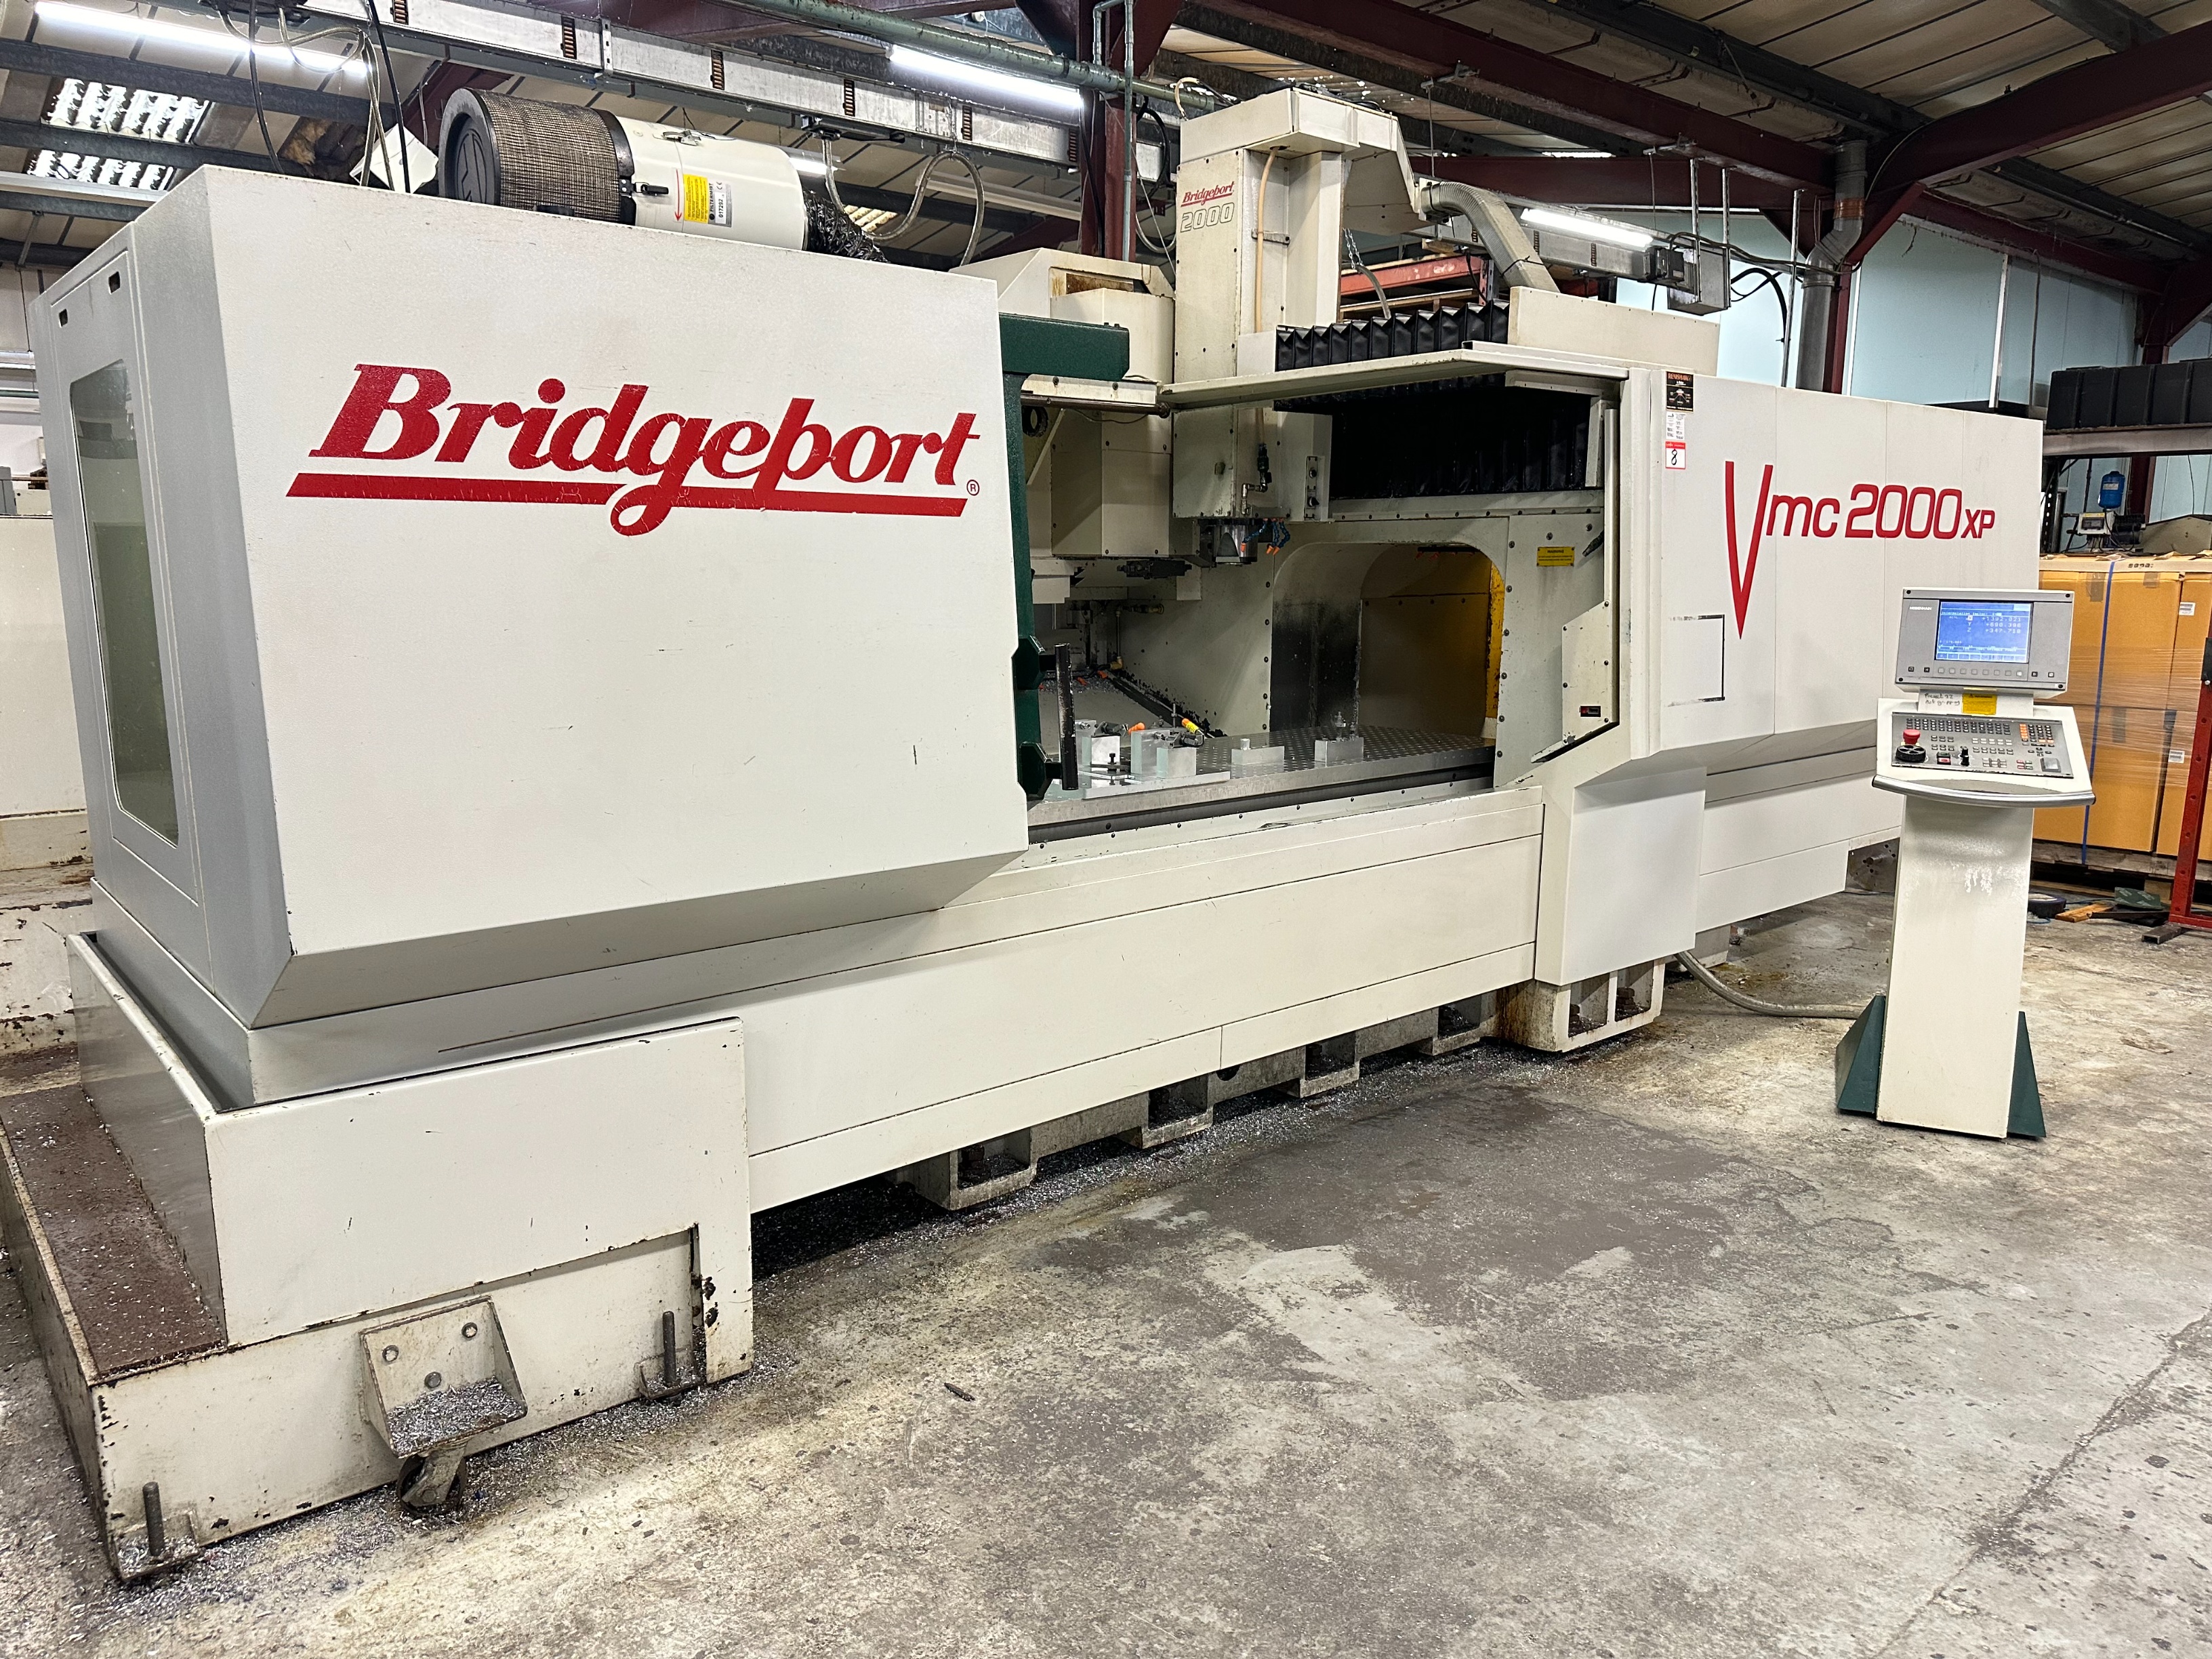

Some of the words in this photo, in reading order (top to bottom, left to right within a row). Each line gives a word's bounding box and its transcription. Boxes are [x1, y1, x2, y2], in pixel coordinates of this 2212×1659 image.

[1182, 182, 1235, 205] Bridgeport
[1180, 202, 1235, 233] 2000
[308, 363, 981, 536] Bridgeport
[1671, 449, 1678, 466] 8
[1725, 460, 1841, 640] Vmc
